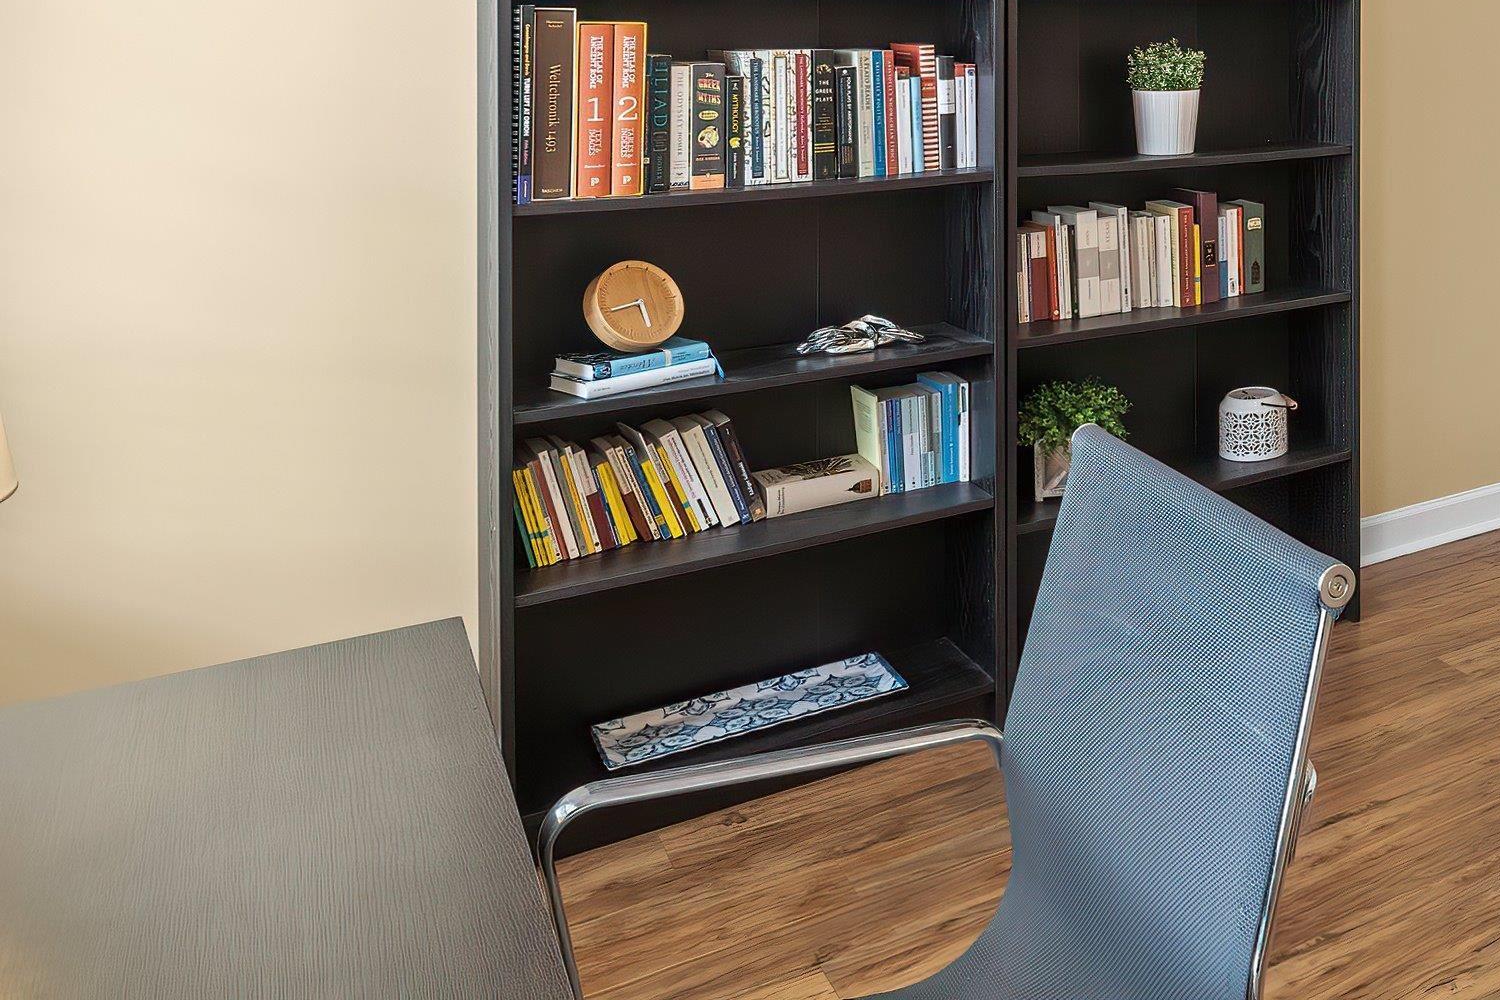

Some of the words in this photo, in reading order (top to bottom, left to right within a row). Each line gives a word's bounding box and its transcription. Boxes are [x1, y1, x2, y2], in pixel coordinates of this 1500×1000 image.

[596, 74, 603, 84] OF
[629, 72, 636, 82] OF
[548, 64, 561, 127] Weltchronik
[653, 67, 668, 127] ILIAD
[696, 91, 721, 105] MYTHS
[587, 98, 604, 121] 1
[617, 96, 637, 120] 2
[676, 91, 684, 128] ODYSSEY
[731, 94, 739, 133] MYTHOLOGY
[545, 131, 556, 153] 1493
